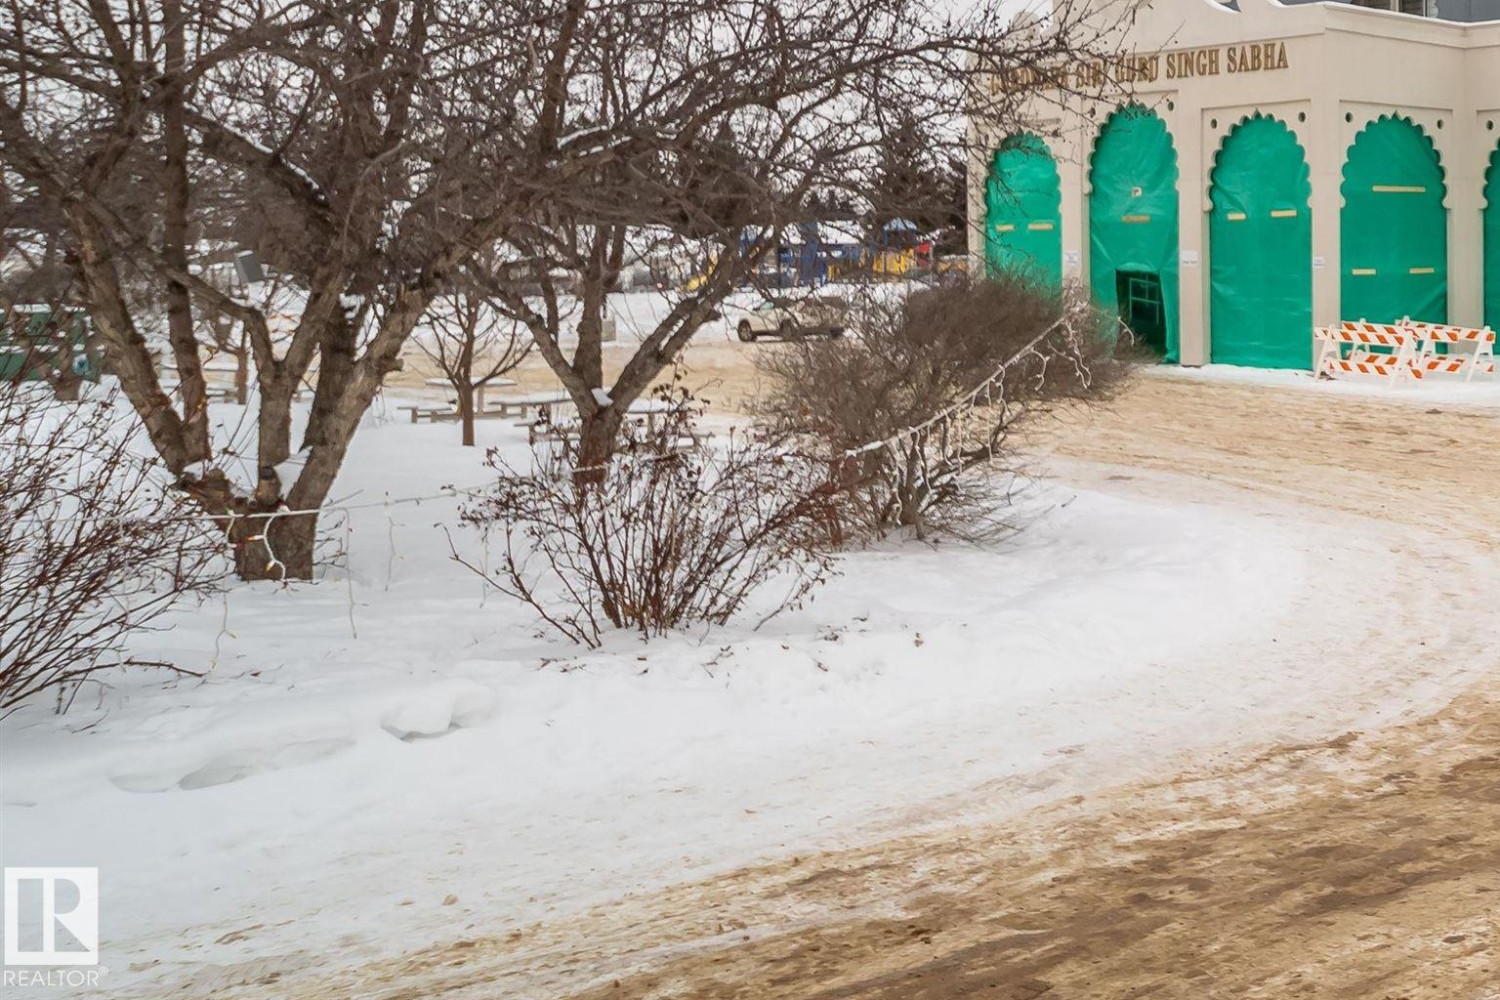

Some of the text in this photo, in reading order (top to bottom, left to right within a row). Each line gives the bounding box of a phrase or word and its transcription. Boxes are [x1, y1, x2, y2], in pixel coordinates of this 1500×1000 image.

[1115, 55, 1160, 84] GURU
[1166, 49, 1220, 79] SINGH
[1227, 41, 1289, 73] SABHA
